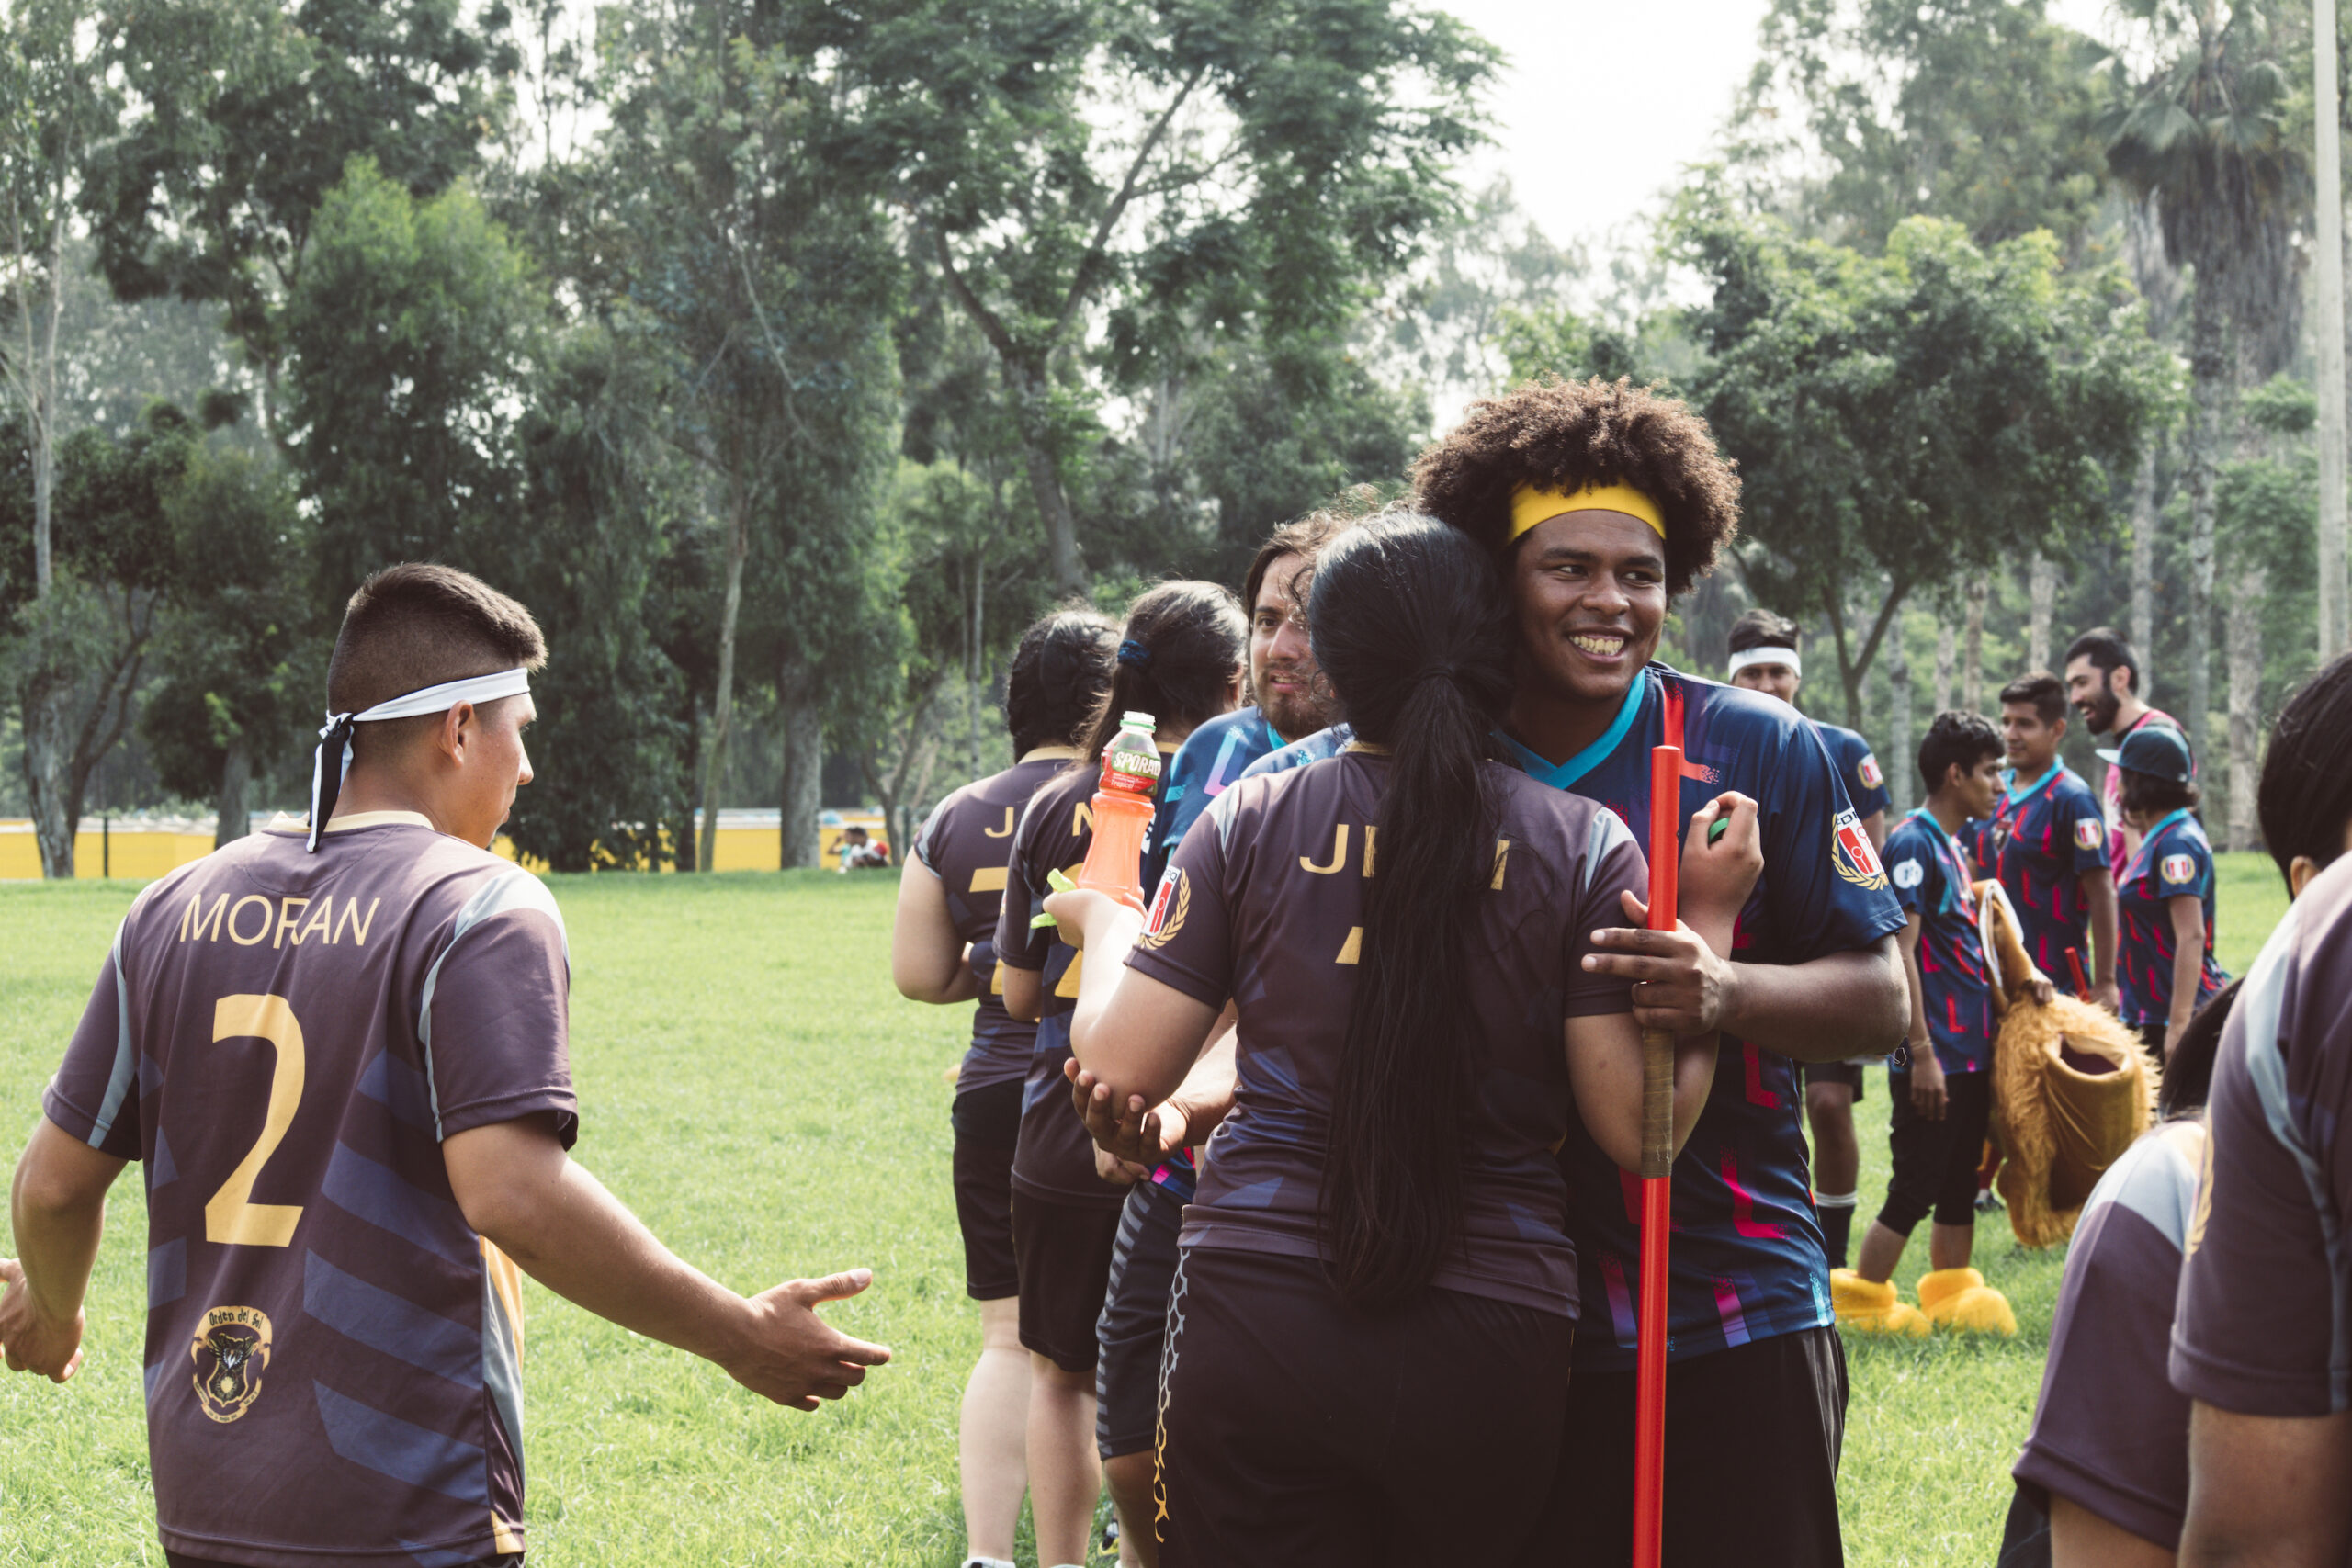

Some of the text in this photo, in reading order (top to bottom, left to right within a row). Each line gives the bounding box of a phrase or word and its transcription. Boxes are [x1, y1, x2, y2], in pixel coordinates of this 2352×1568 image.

[179, 892, 381, 950] MORAN
[205, 992, 305, 1247] 2
[209, 1308, 264, 1329] Orden del Sol
